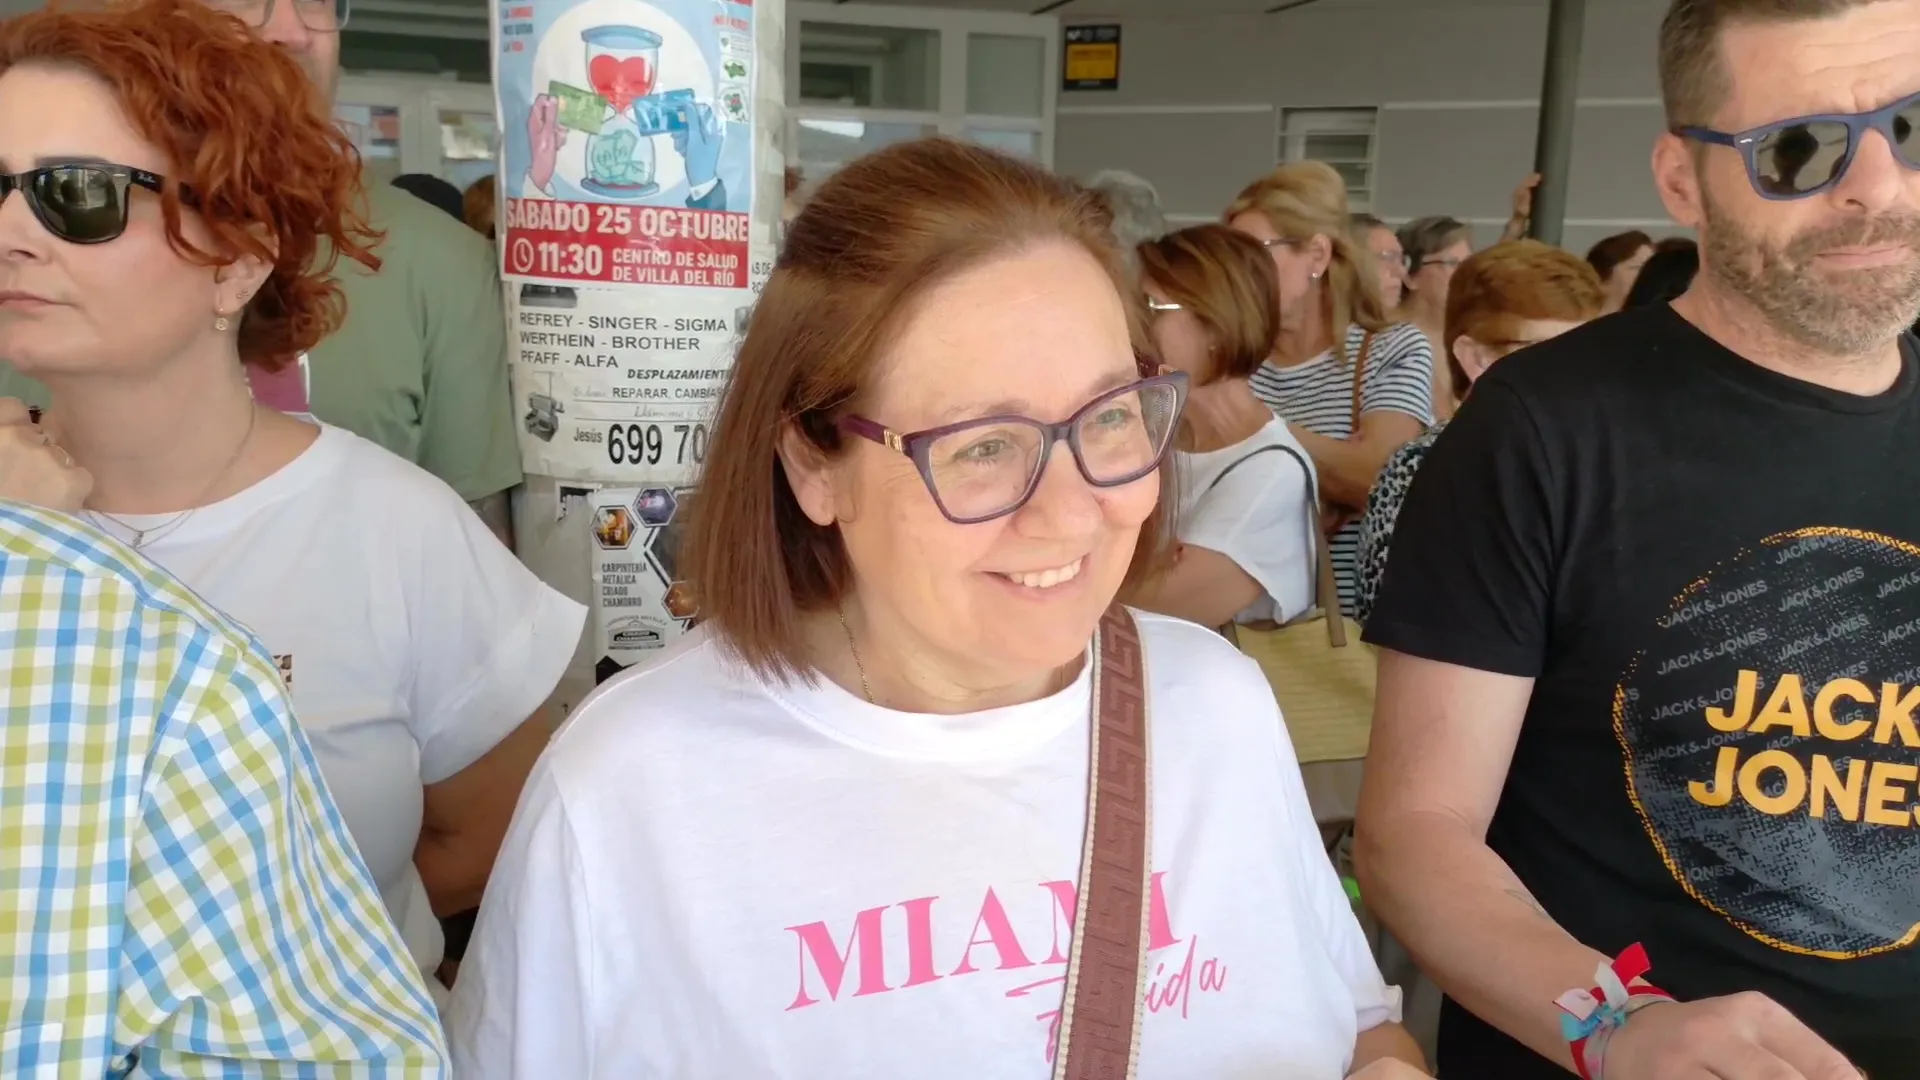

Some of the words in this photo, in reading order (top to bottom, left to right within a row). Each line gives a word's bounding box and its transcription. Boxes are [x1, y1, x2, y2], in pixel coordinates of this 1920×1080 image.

[597, 205, 632, 235] 25
[640, 208, 748, 242] OCTUBRE
[538, 241, 603, 276] 11:30
[612, 248, 672, 265] CENTRO
[675, 251, 695, 267] DE
[697, 252, 738, 269] SALUD
[612, 266, 632, 281] DE
[636, 267, 680, 284] VILLA
[684, 270, 710, 285] DEL
[713, 268, 736, 286] RÍO
[520, 312, 573, 327] REFREY
[588, 316, 657, 330] SINGER
[674, 318, 727, 331] SIGMA
[520, 331, 595, 348] WERTHEIN
[612, 336, 700, 350] BROTHER
[521, 350, 560, 365] PFAFF
[574, 354, 619, 368] ALFA
[573, 428, 603, 443] Jesús
[608, 423, 663, 465] 699
[1704, 669, 1920, 747] JACK
[1688, 746, 1920, 827] JONE
